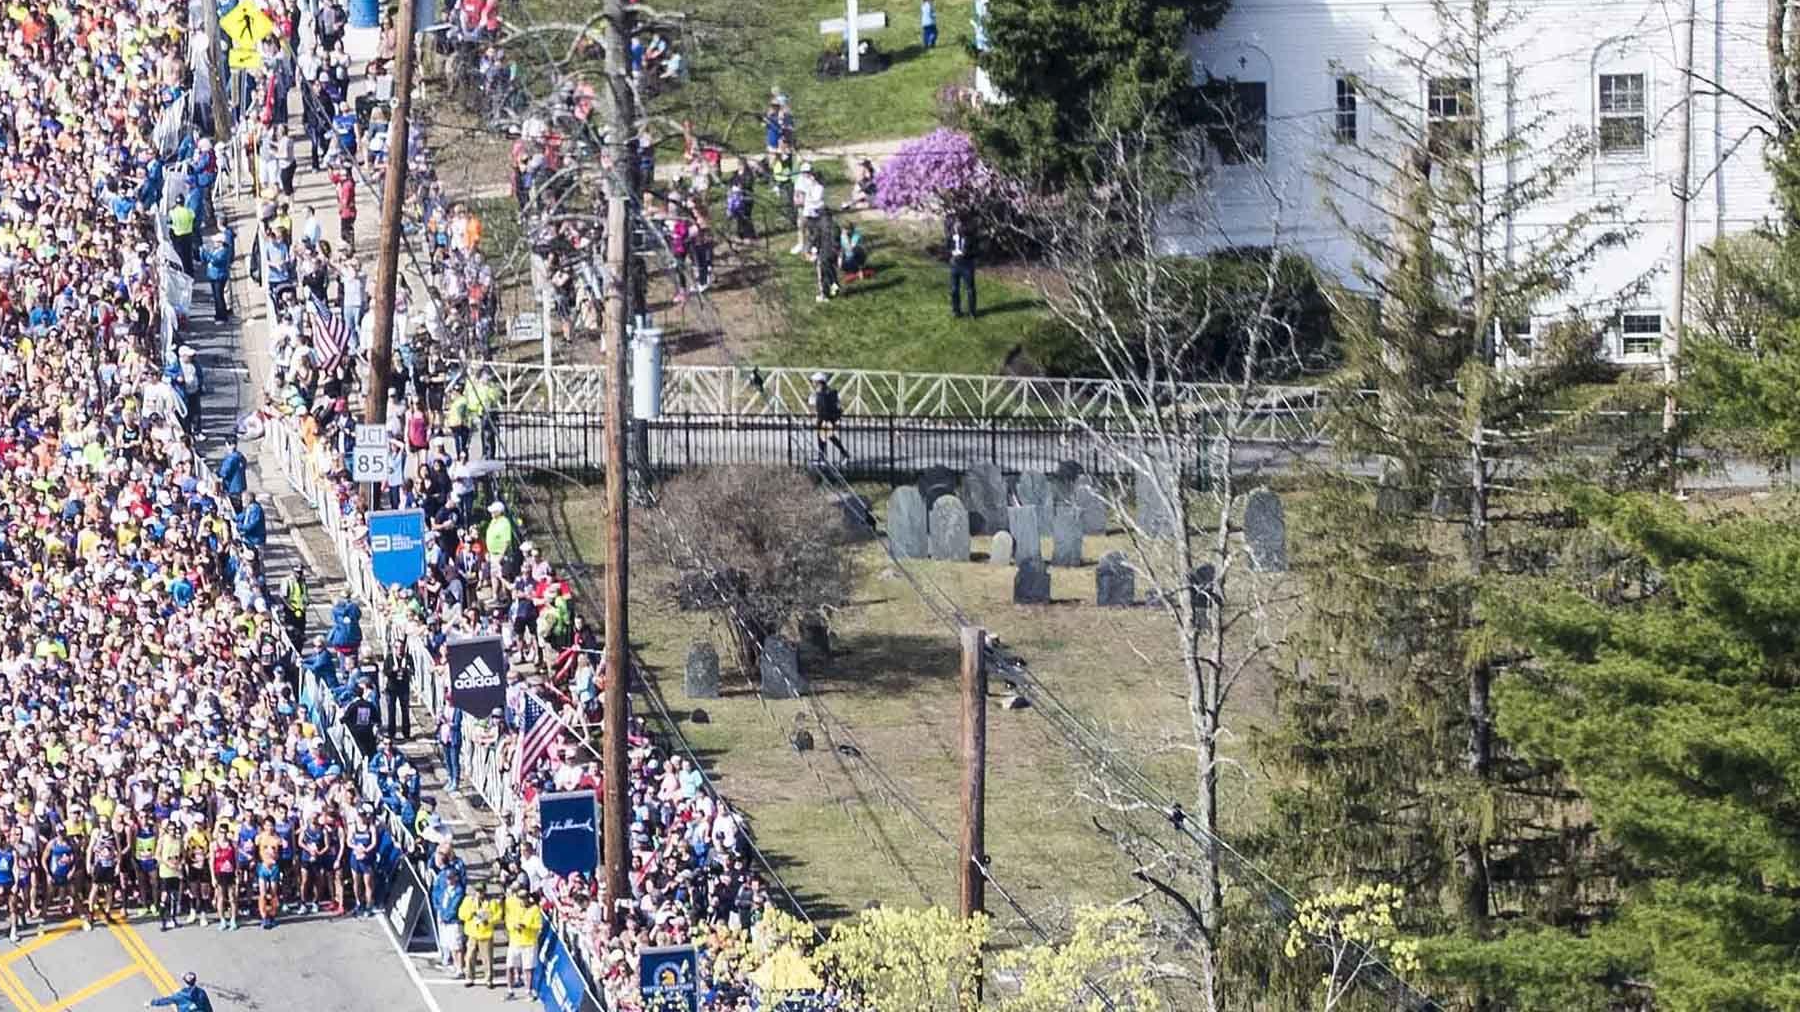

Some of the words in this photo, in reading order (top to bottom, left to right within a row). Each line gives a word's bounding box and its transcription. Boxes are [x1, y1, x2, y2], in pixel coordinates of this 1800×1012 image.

[359, 428, 382, 443] JCT
[358, 455, 384, 473] 85
[454, 672, 501, 690] adidas
